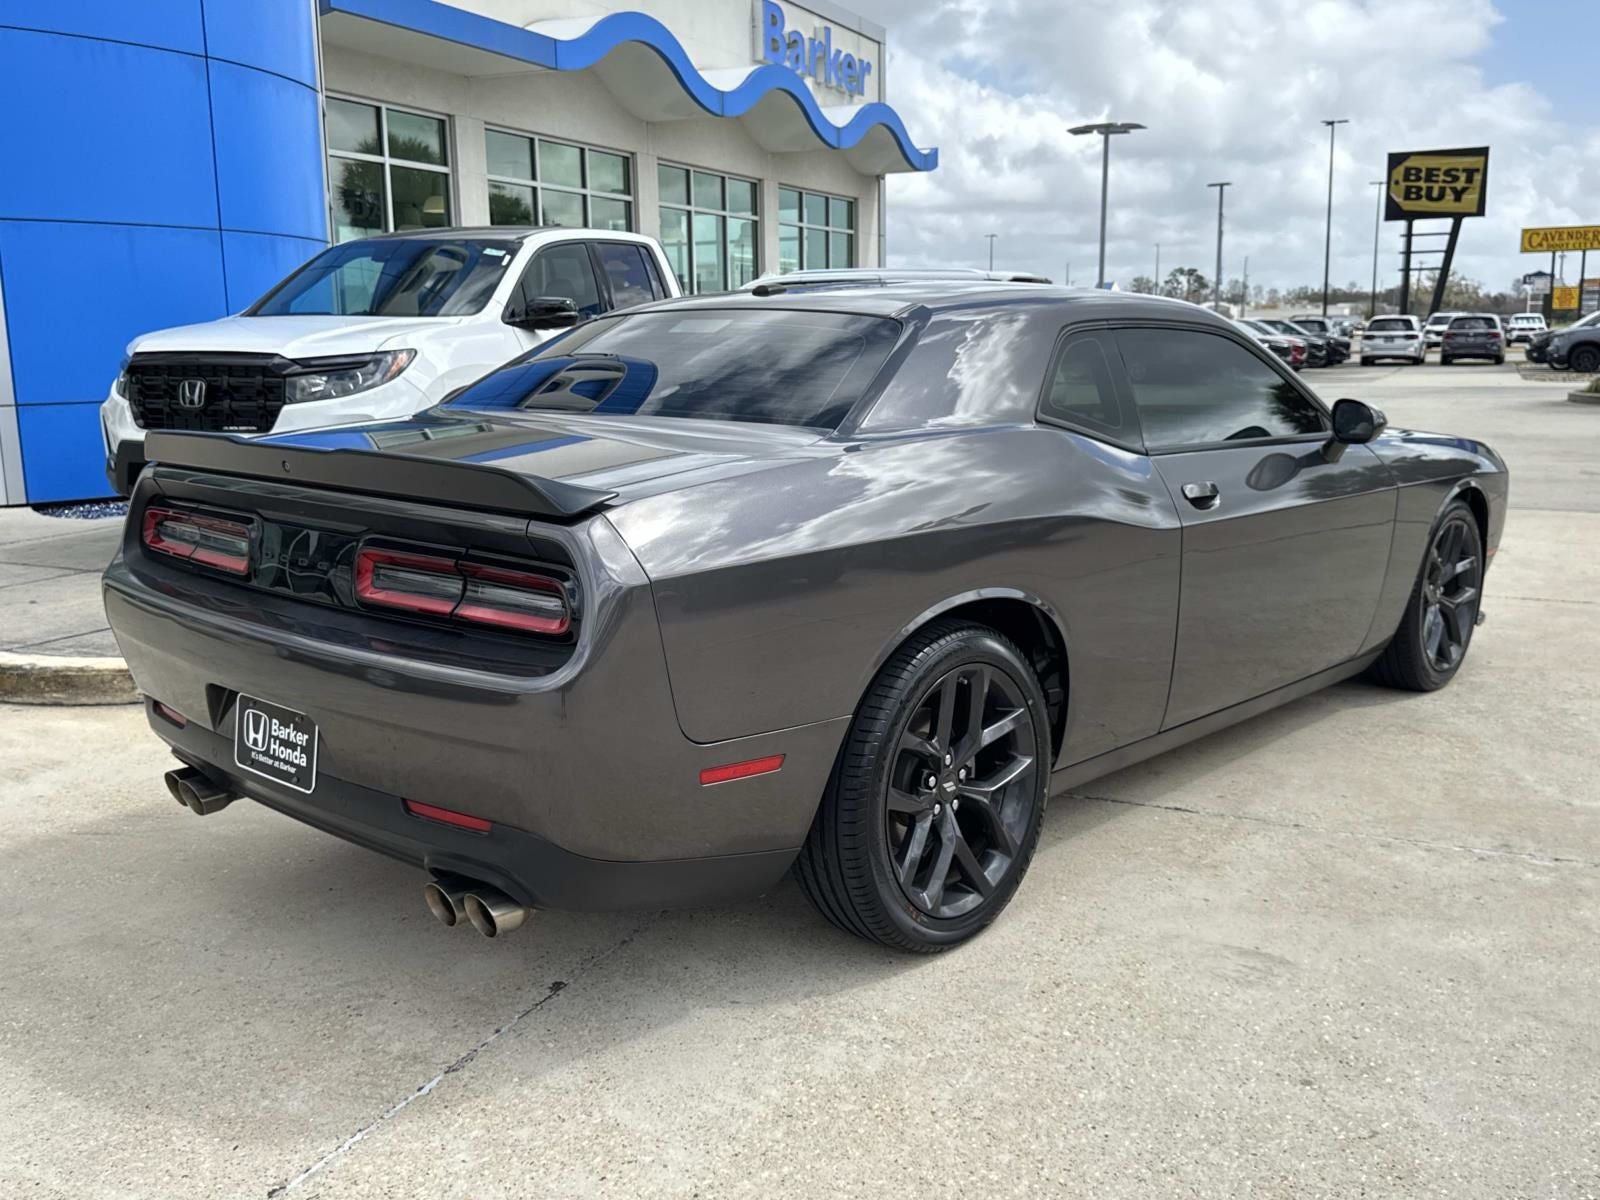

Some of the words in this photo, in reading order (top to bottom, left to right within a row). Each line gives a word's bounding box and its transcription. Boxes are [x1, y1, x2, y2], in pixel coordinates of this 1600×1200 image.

[763, 0, 872, 97] Barker
[1403, 166, 1480, 184] BEST
[1404, 185, 1471, 202] BUY
[271, 719, 309, 746] Barker
[270, 738, 307, 767] Honda
